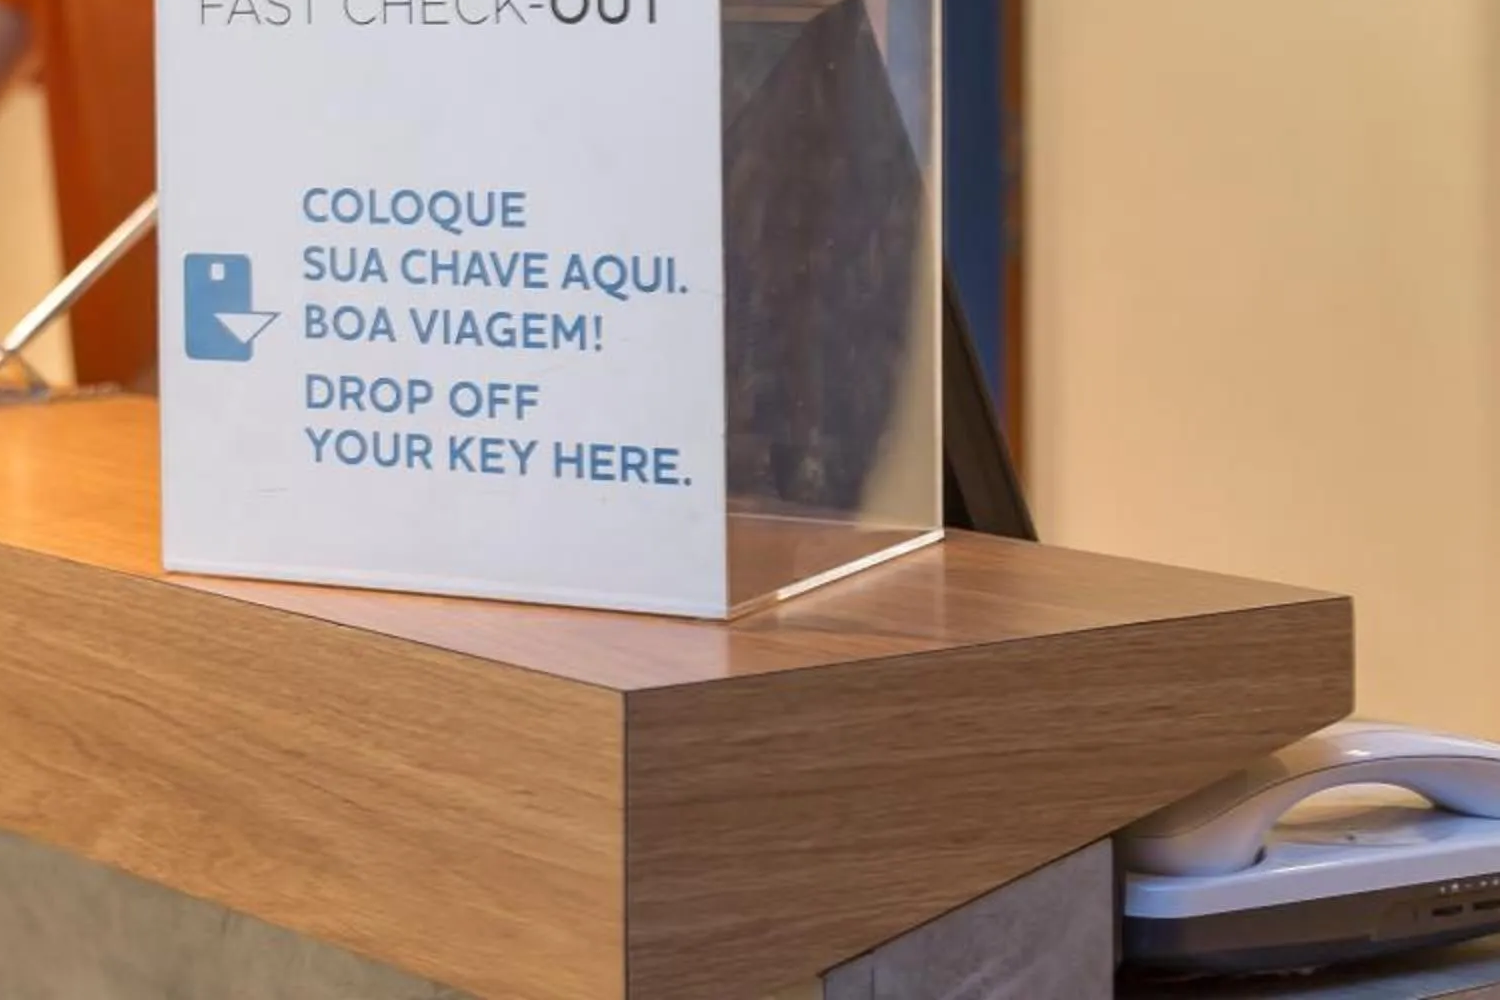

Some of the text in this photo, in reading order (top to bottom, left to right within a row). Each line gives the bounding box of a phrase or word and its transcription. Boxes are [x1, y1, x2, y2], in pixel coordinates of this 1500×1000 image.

[302, 187, 527, 235] COLOQUE
[303, 246, 689, 301] SUA CHAVE AQUI.
[304, 304, 603, 352] BOA VIAGEM!
[305, 374, 540, 421] DROP OFF
[304, 428, 692, 487] YOUR KEY HERE.
